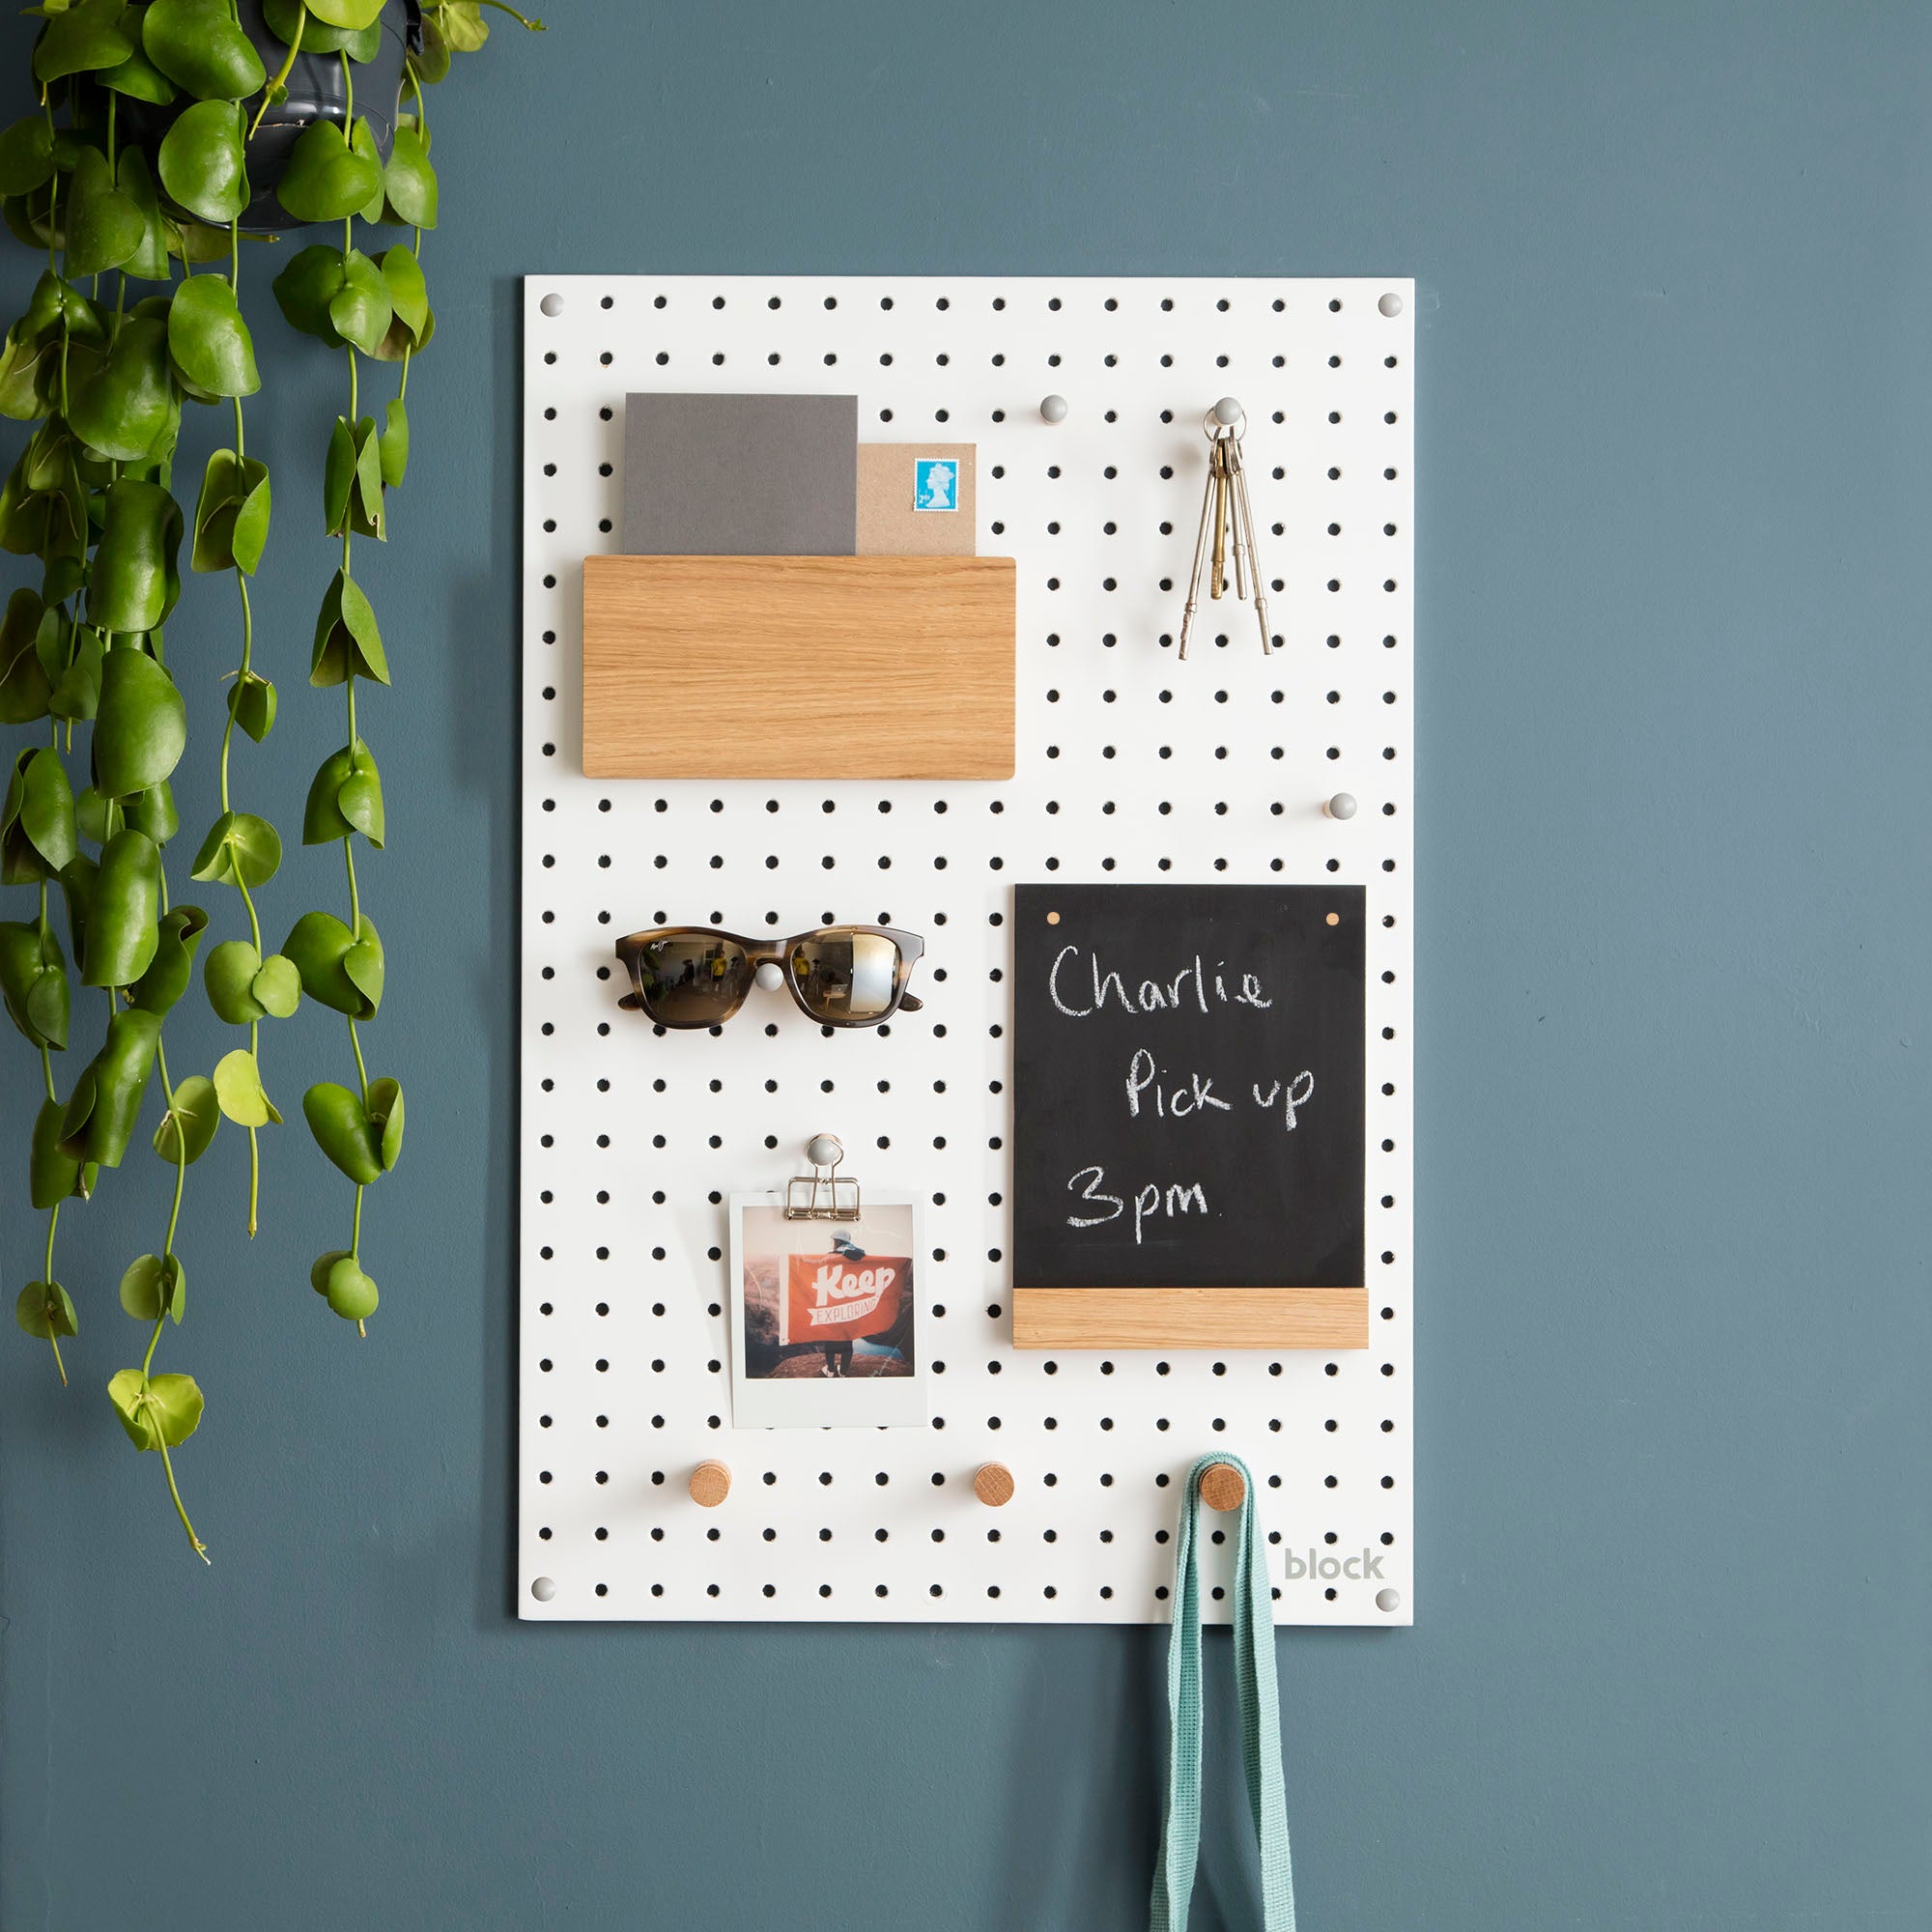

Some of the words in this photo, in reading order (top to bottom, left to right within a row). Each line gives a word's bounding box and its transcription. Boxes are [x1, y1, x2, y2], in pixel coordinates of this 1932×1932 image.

[1049, 946, 1272, 1016] Charlie
[1126, 1049, 1232, 1117] Pick
[1253, 1070, 1314, 1131] up
[811, 1264, 895, 1307] Keep
[816, 1298, 876, 1323] EXPLORING
[1285, 1548, 1385, 1579] block
